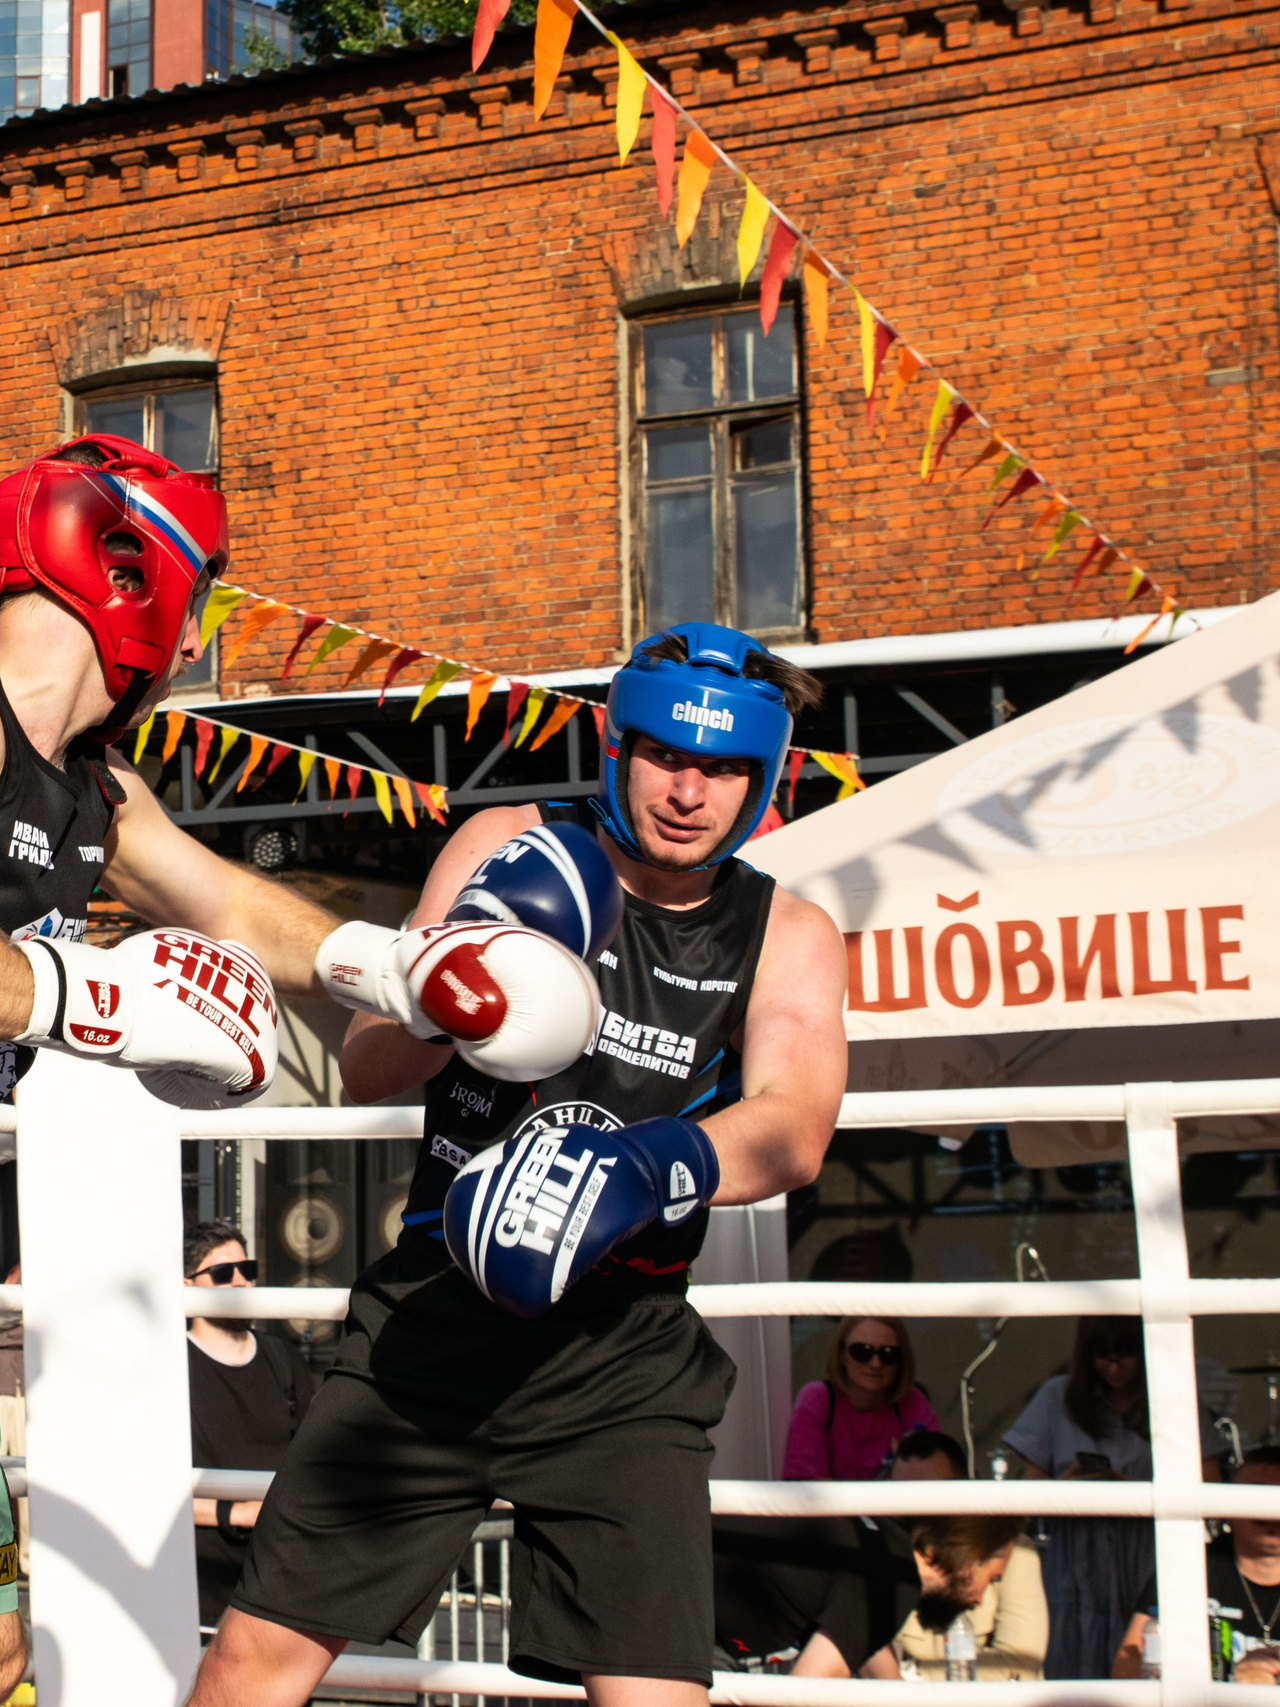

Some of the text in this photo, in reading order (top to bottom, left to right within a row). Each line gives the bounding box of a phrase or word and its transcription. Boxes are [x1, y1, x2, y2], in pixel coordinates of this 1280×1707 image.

[672, 700, 734, 732] clinch
[13, 820, 49, 849] ИВАН
[153, 933, 278, 1029] GREEN
[153, 943, 260, 1038] HILL
[330, 962, 364, 976] GREEN
[331, 974, 359, 987] HILL
[653, 966, 698, 991] КУЛЬТУРНО
[186, 992, 255, 1056] BE YOUR BEST SELF
[602, 1011, 697, 1064] БИТВА
[598, 1038, 691, 1080] ОБЩЕПИТОВ
[495, 1127, 569, 1248] GREEN
[519, 1148, 594, 1256] HILL
